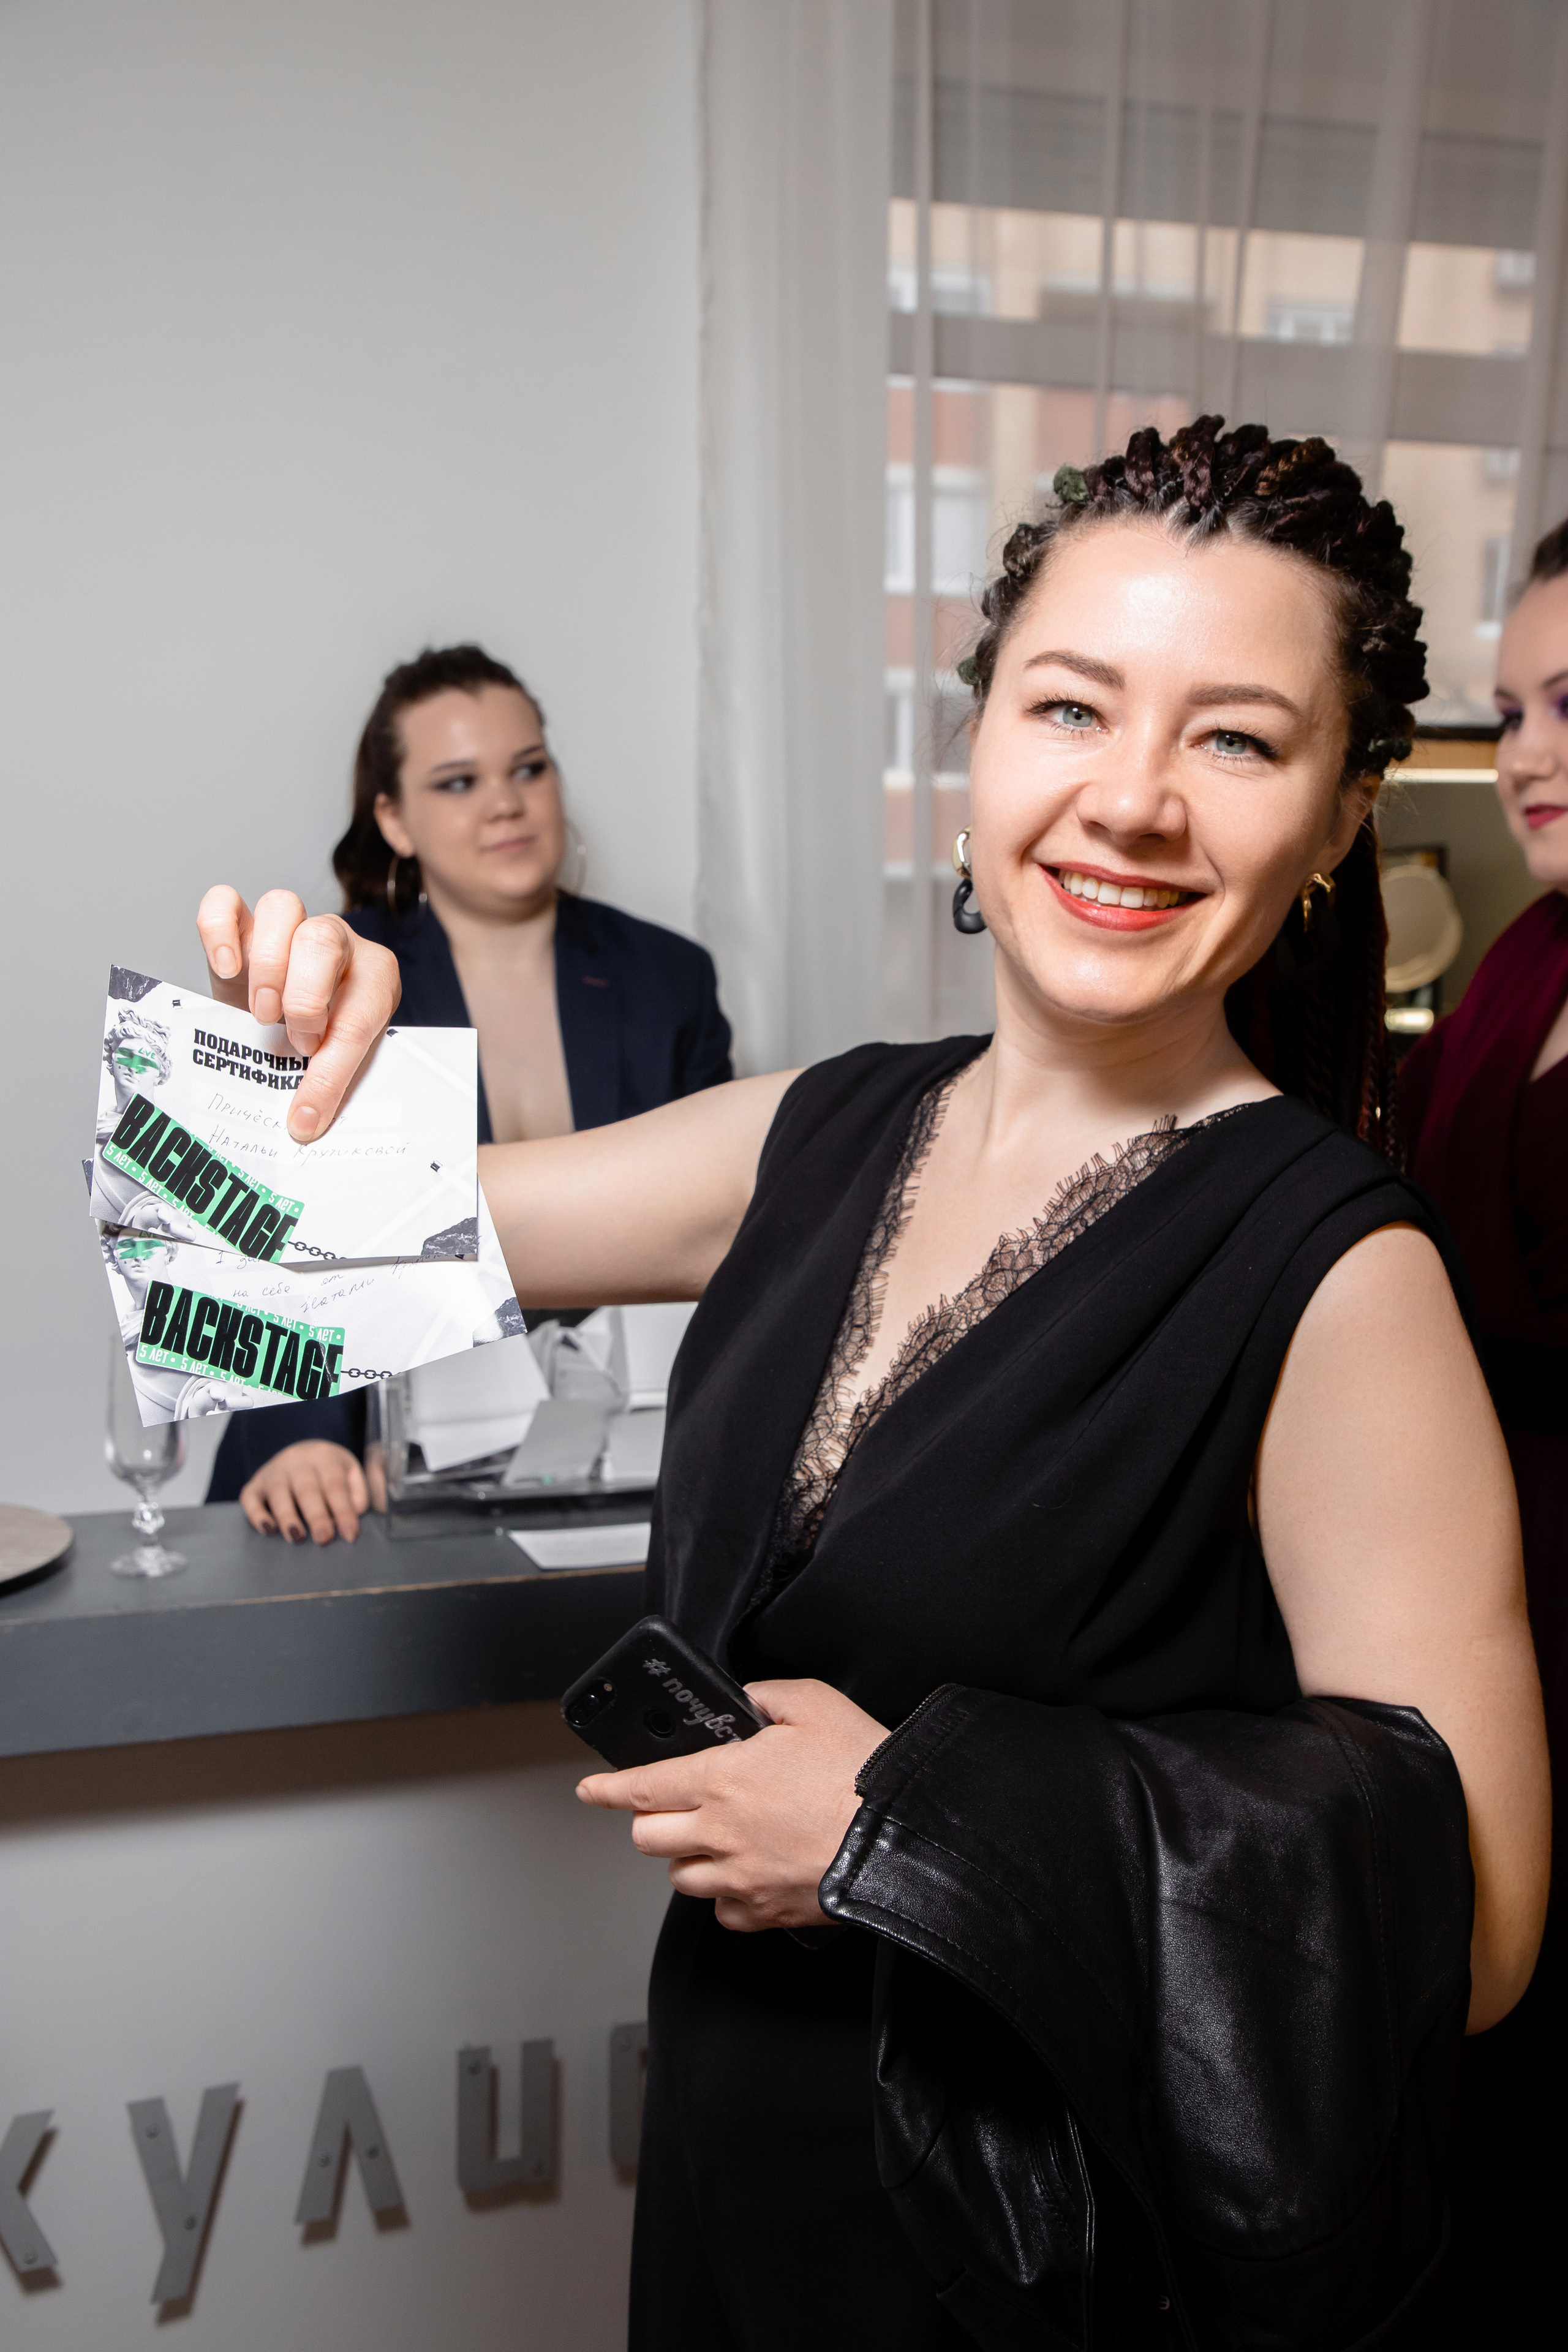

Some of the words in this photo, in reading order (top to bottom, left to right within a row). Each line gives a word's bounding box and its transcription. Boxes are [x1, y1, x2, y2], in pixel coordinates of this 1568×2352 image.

[193, 1049, 304, 1090] СЕРТИФИКА
[194, 1028, 312, 1071] ПОДАРОЧНЫ
[106, 1144, 116, 1156] 5
[138, 1171, 148, 1183] 5
[110, 1093, 298, 1262] BACKSTAGE
[268, 1193, 277, 1204] 5
[140, 1280, 344, 1400] BACKSTAGE
[308, 1325, 315, 1337] 5
[140, 1344, 148, 1357] 5
[181, 1358, 189, 1370] 5
